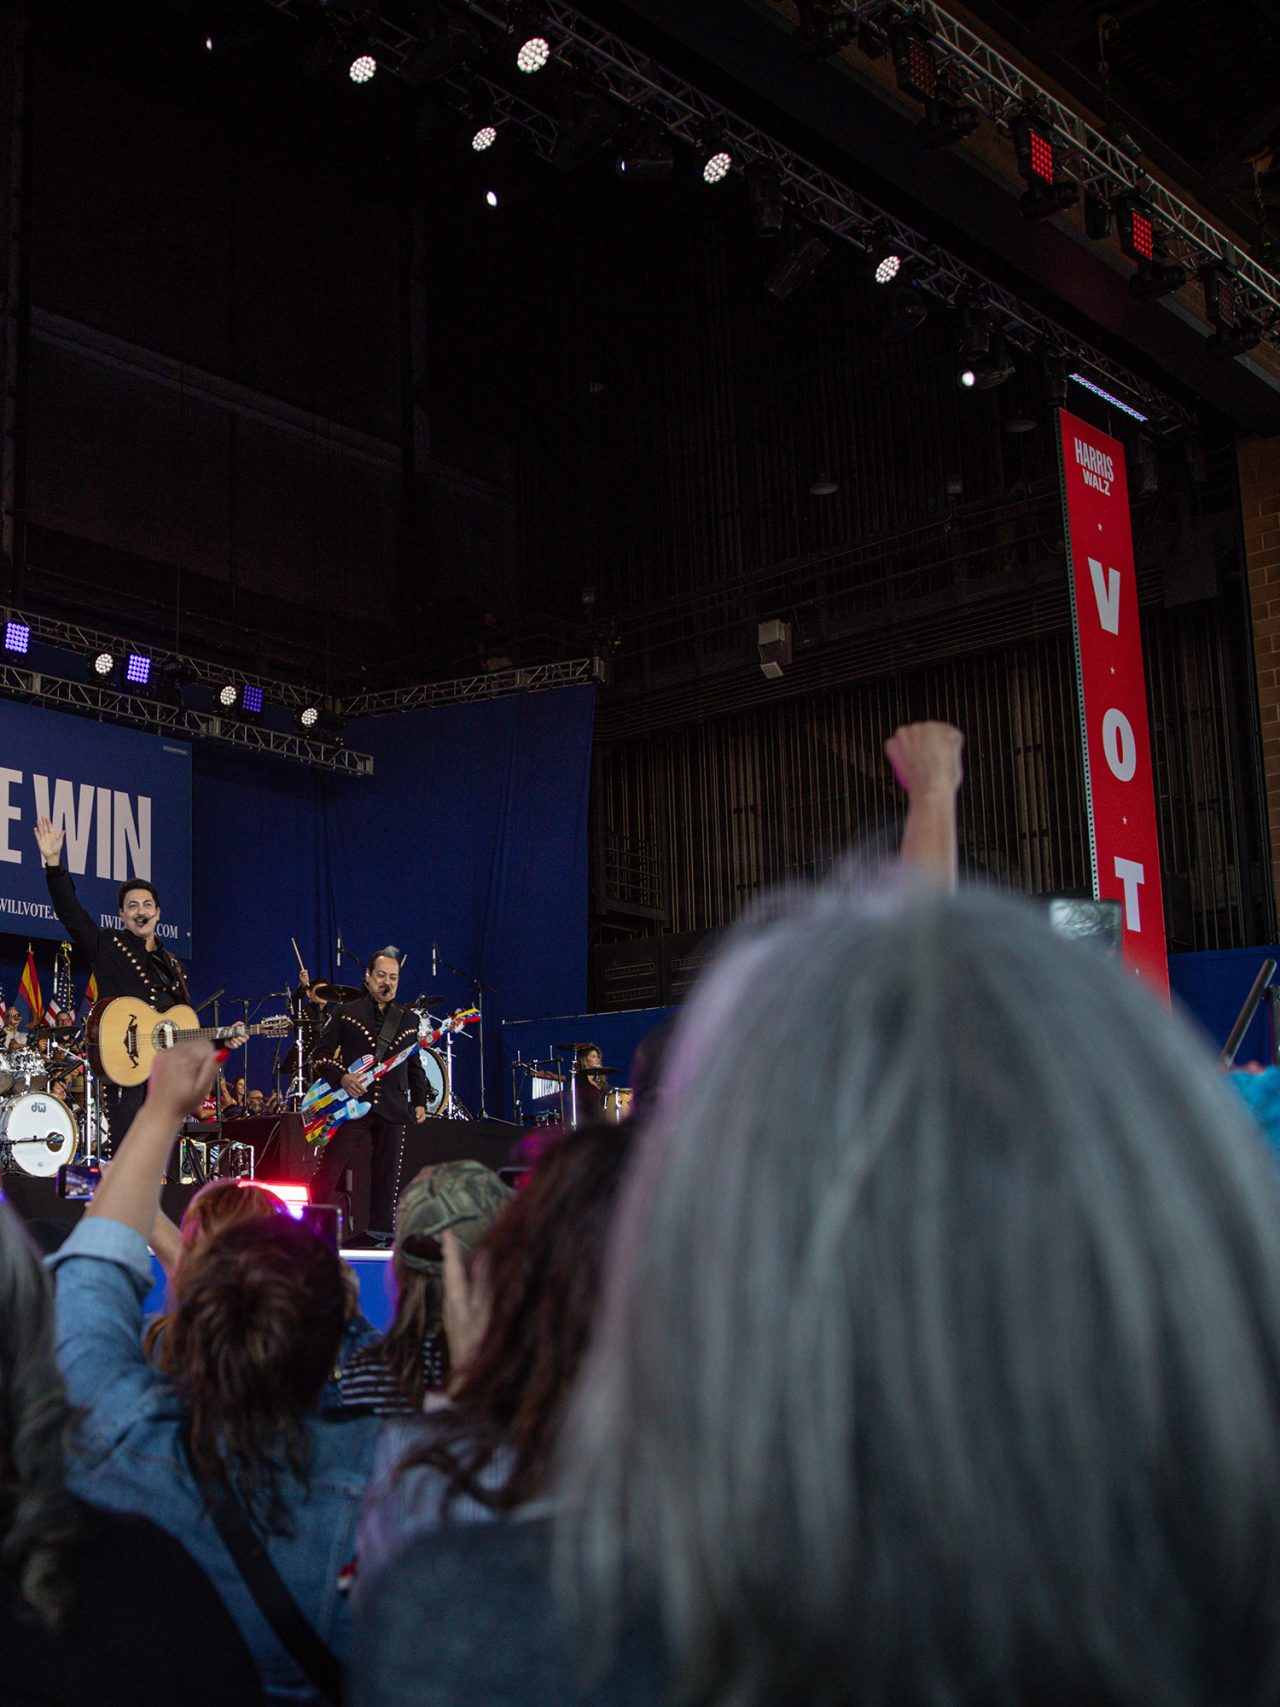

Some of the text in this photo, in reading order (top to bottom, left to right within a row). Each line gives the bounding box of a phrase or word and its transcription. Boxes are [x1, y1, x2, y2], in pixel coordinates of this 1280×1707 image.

[1074, 436, 1114, 482] HARRIS
[1082, 468, 1111, 496] WALZ
[33, 774, 152, 884] WIN
